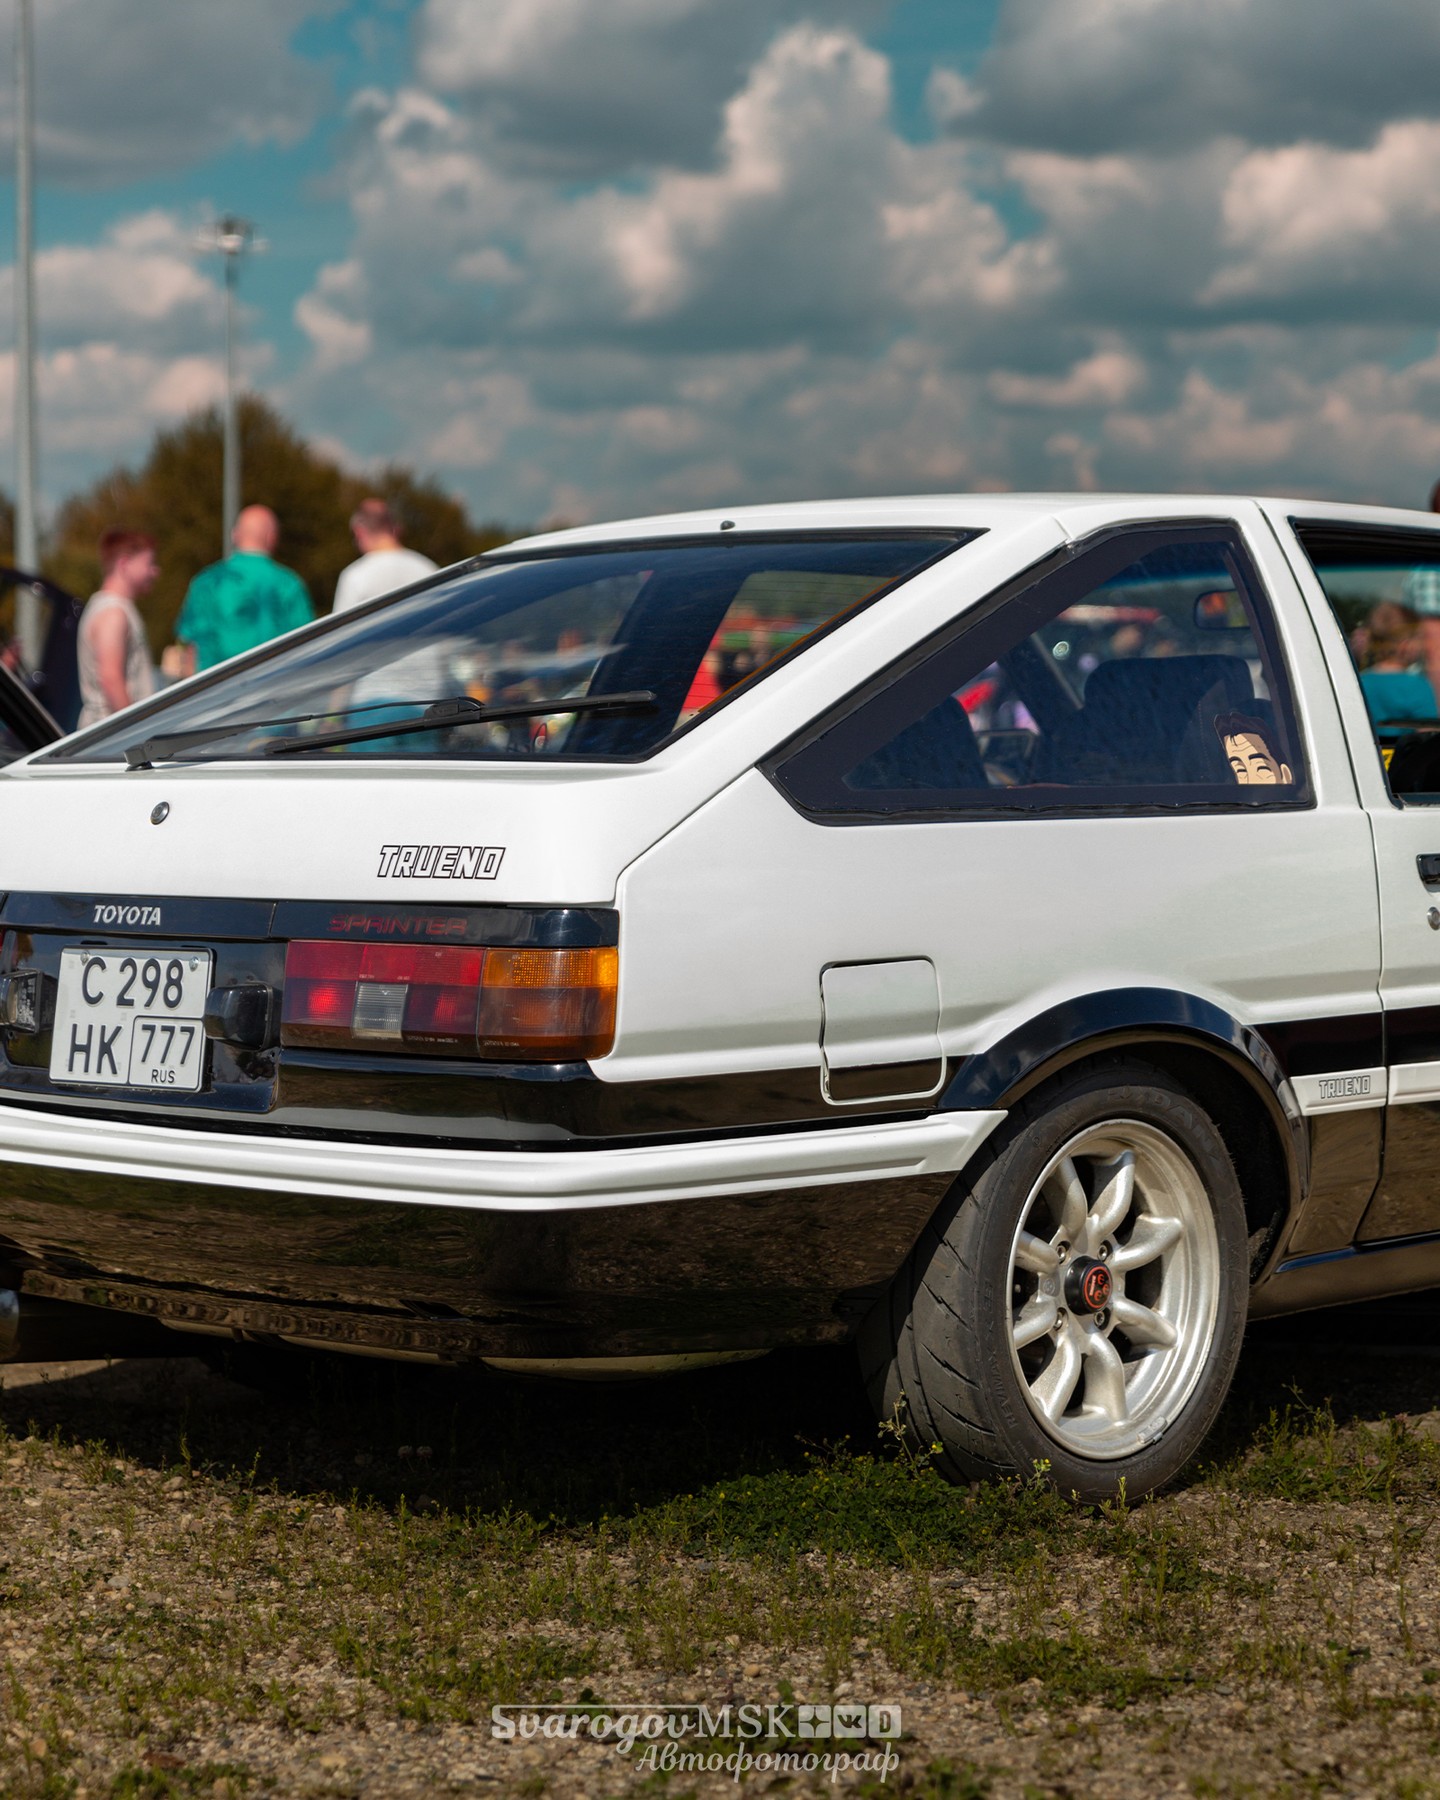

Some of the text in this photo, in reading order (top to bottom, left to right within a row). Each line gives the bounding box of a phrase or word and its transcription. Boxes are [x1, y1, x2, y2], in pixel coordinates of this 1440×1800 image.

[377, 844, 506, 880] TRUENO
[93, 904, 161, 926] TOYOTA
[327, 914, 468, 936] SPRINTER
[116, 957, 184, 1009] 298
[141, 1023, 196, 1066] 777
[151, 1068, 176, 1085] RUS
[1319, 1074, 1371, 1100] TRUENO
